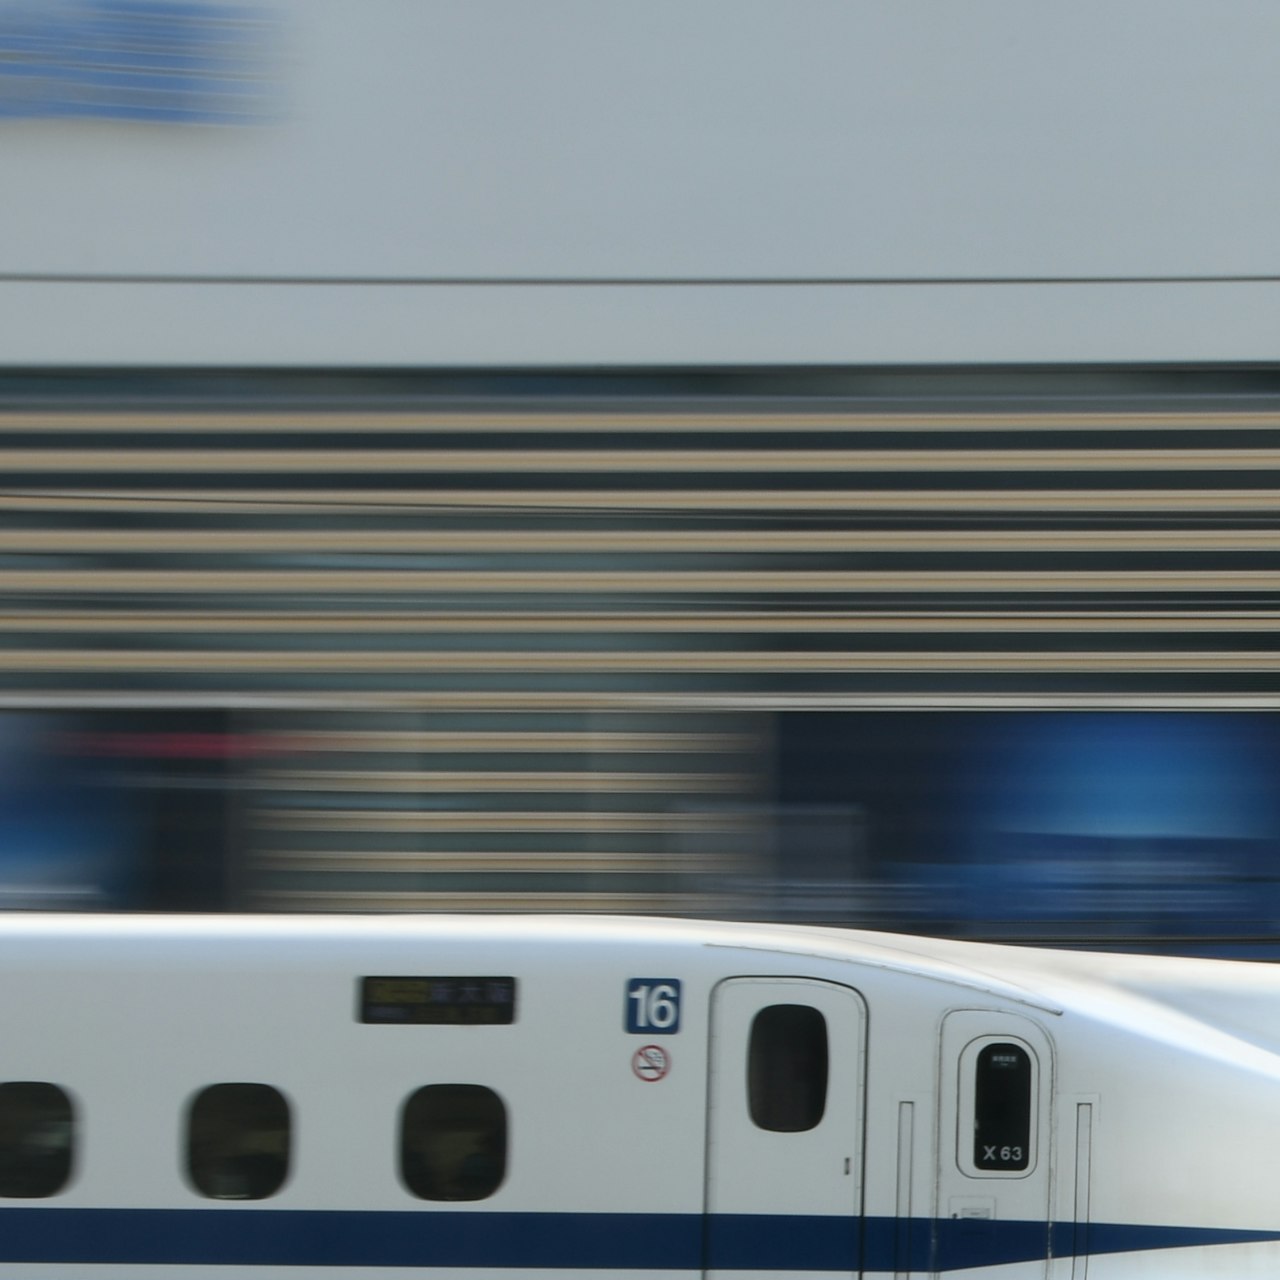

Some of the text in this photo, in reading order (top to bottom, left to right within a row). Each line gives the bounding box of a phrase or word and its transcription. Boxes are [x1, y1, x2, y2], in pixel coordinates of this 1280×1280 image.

[629, 985, 678, 1028] 16
[983, 1145, 1022, 1161] X 63
